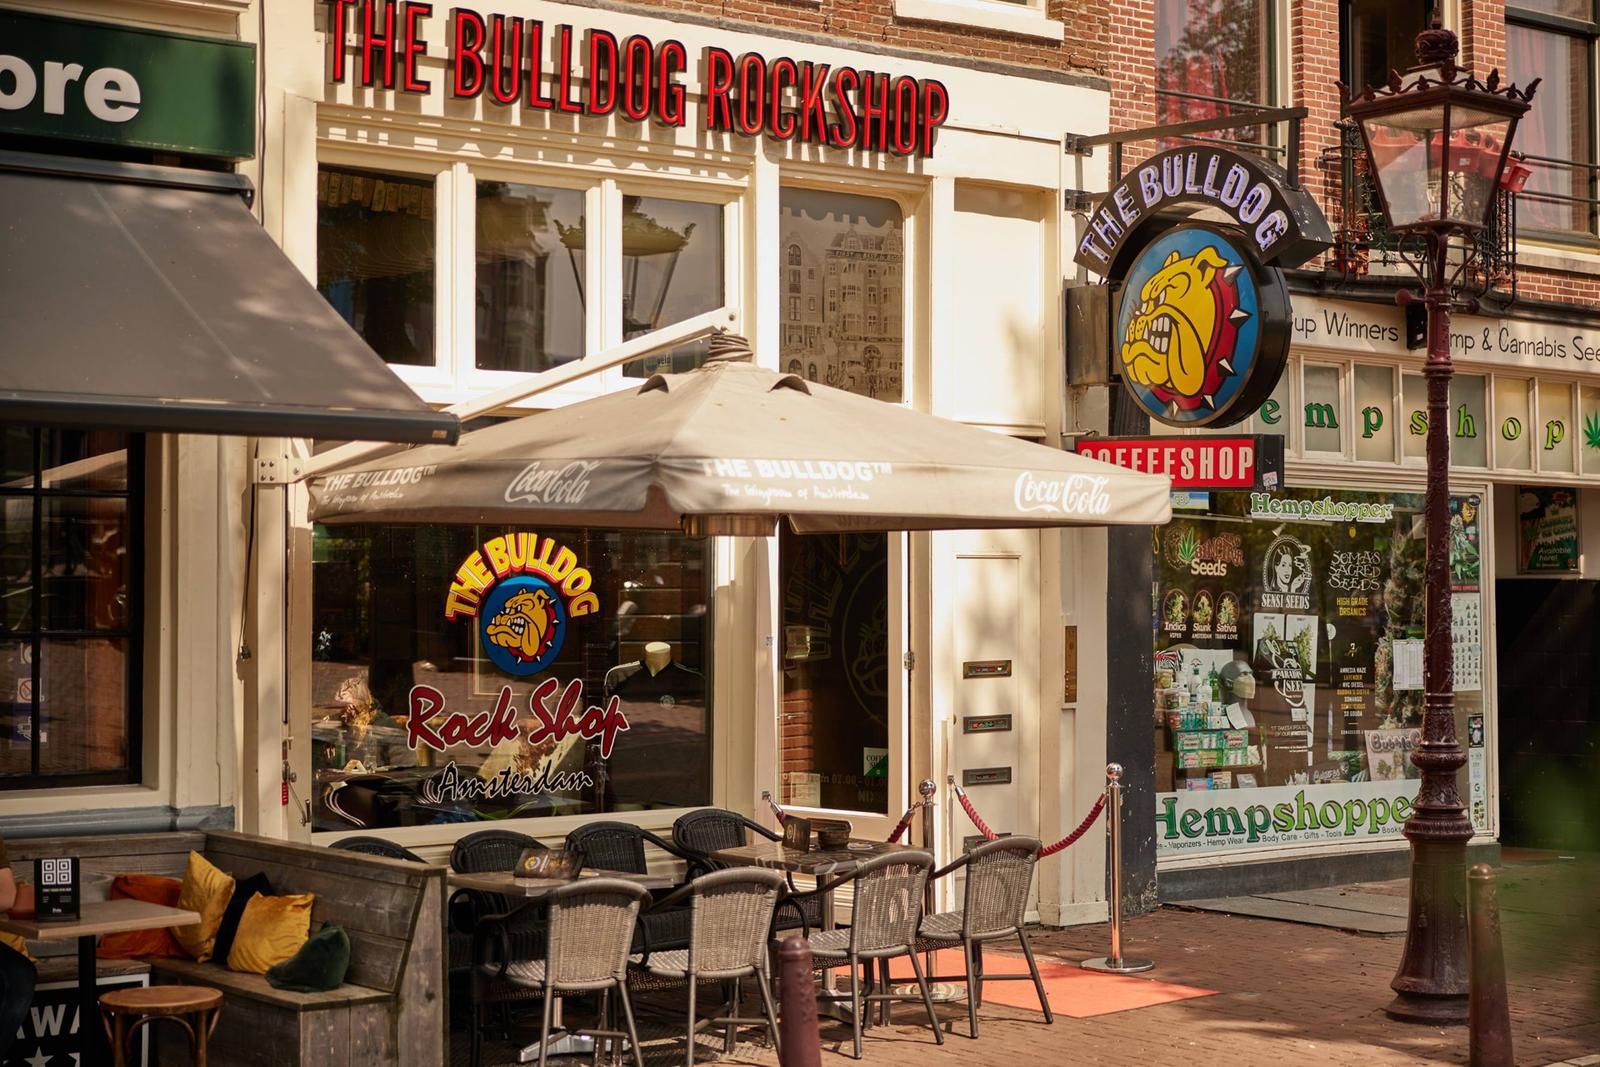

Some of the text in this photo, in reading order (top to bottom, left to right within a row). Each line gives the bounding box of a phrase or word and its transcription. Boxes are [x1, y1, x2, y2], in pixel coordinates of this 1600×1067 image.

[0, 55, 141, 123] ore
[331, 0, 949, 158] THE BULLDOG ROCKSHOP
[1080, 152, 1288, 264] THE BULLDOG
[1324, 309, 1399, 342] Winners
[1481, 327, 1493, 350] &
[1499, 327, 1567, 358] Cannabis
[695, 458, 752, 478] THE
[1081, 446, 1254, 480] FFEESHOP
[322, 475, 351, 492] THE
[504, 460, 601, 504] Coca-Cola
[1013, 471, 1112, 515] Coca-Cola
[1251, 493, 1393, 521] Hempshopper
[445, 532, 600, 623] THE BULLDOG
[1190, 558, 1227, 576] Seeds
[1261, 593, 1310, 609] SENSI SEEDS
[1164, 621, 1187, 631] Indica
[1193, 622, 1212, 632] Skunk
[1216, 623, 1237, 633] Sativa
[407, 677, 631, 759] Rock Shop
[437, 760, 594, 804] Amsterdam
[1156, 790, 1417, 843] Hempshoppe
[1207, 838, 1226, 848] Hemp
[1228, 836, 1245, 845] Wear
[1262, 834, 1279, 844] Body
[1281, 833, 1298, 842] Care
[1304, 831, 1320, 840] Gifts
[1325, 829, 1342, 839] Tools
